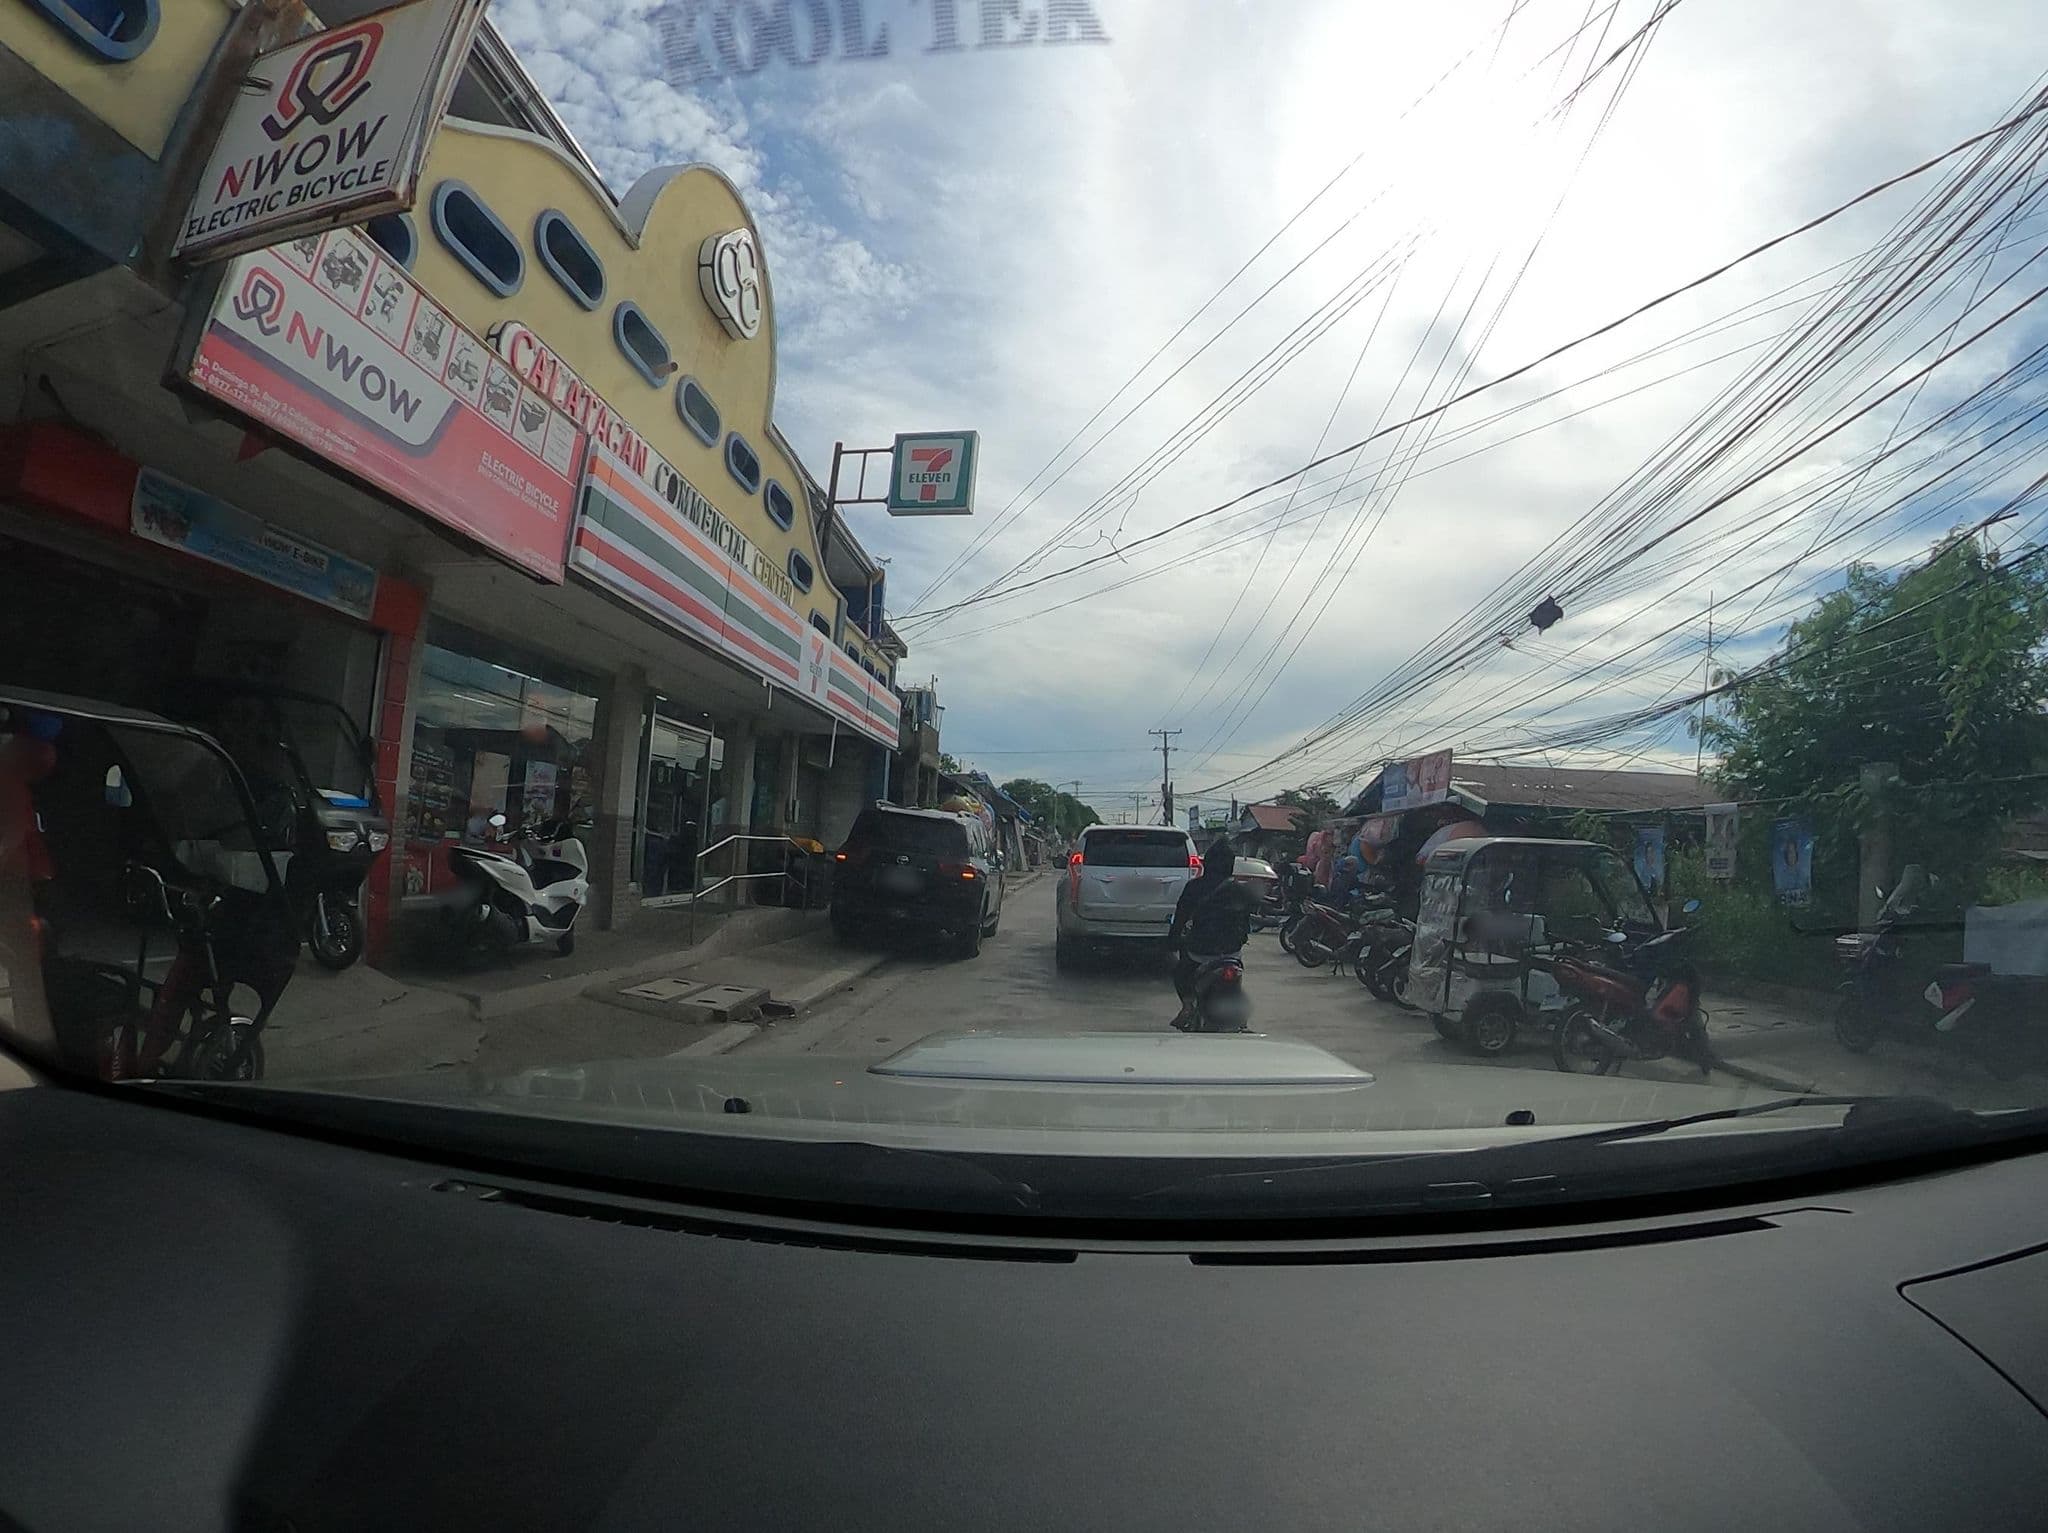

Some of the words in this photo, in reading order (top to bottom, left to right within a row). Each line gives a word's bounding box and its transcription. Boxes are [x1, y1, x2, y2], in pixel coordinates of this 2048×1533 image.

[185, 190, 284, 238] ELECTRIC
[286, 159, 389, 210] BICYCLE
[215, 115, 388, 204] NWOW
[286, 310, 422, 423] NWOW
[481, 450, 525, 490] ELECTRIC
[525, 481, 560, 513] BICYCLE
[911, 447, 952, 501] 7
[654, 461, 749, 569] COMMERCIAL
[753, 551, 795, 607] CENTER
